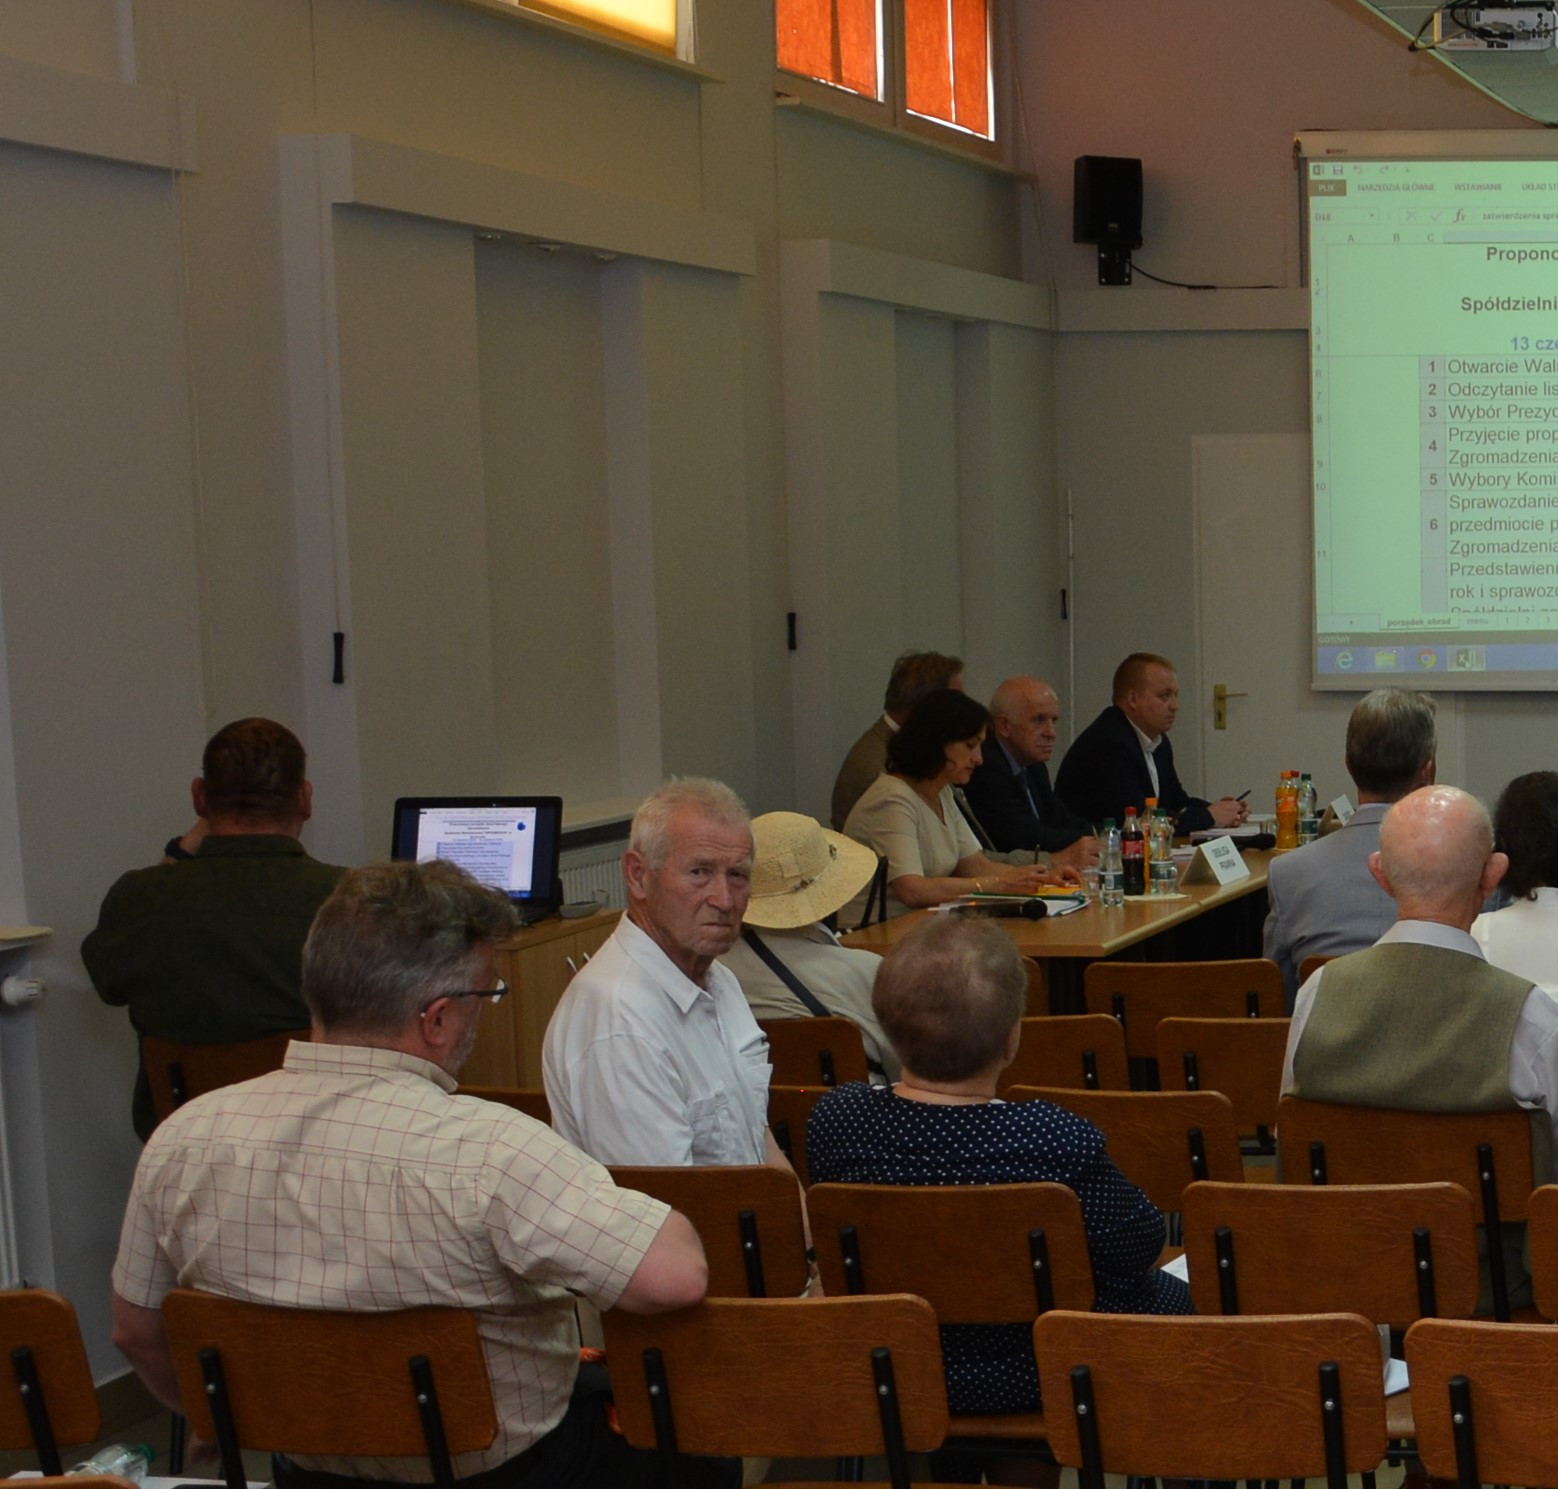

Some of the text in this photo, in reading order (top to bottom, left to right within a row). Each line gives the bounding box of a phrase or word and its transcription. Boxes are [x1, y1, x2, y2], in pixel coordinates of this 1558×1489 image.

[1318, 184, 1336, 192] PLIK
[1454, 183, 1502, 191] WSTAWIANIE
[1483, 211, 1540, 220] zatwierdzenia
[1347, 234, 1354, 242] A
[1393, 234, 1400, 242] B
[1427, 234, 1434, 242] C
[1460, 296, 1558, 314] Spółdzielni
[1510, 336, 1530, 351] 13
[1428, 361, 1436, 372] 1
[1448, 359, 1519, 374] Otwarcie
[1428, 383, 1437, 396] 2
[1448, 382, 1538, 400] Odczytanie
[1428, 405, 1437, 418] 3
[1448, 404, 1502, 422] Wybór
[1449, 426, 1520, 445] Przyjęcie
[1428, 440, 1437, 452] 4
[1429, 473, 1437, 485] 5
[1448, 472, 1512, 489] Wybory
[1429, 518, 1438, 530] 6
[1449, 516, 1544, 533] przedmiocie
[1449, 584, 1475, 599] rok
